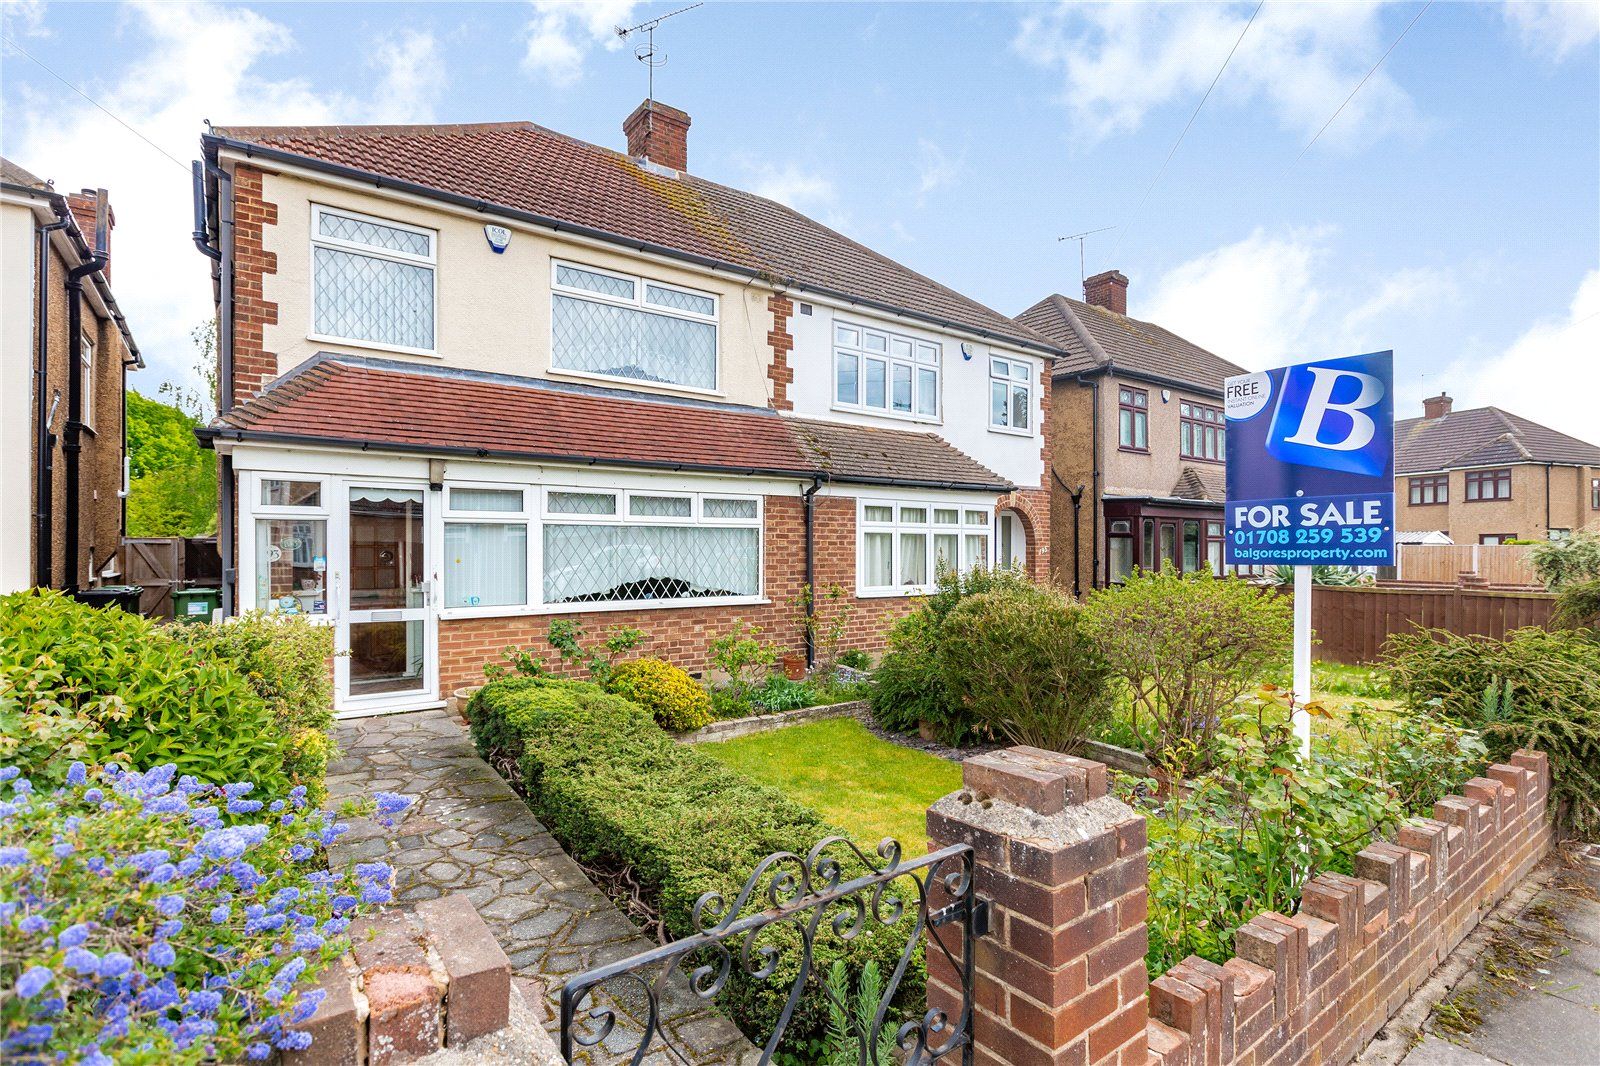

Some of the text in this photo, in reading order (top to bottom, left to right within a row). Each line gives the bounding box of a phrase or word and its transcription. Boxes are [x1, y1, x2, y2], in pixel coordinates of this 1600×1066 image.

[1226, 381, 1259, 399] FREE
[1227, 400, 1255, 409] VALUATION
[1284, 366, 1385, 451] B
[1234, 500, 1383, 529] FOR SALE
[1234, 526, 1382, 545] 01708 259 539
[1234, 547, 1388, 561] balgoresproperty.com
